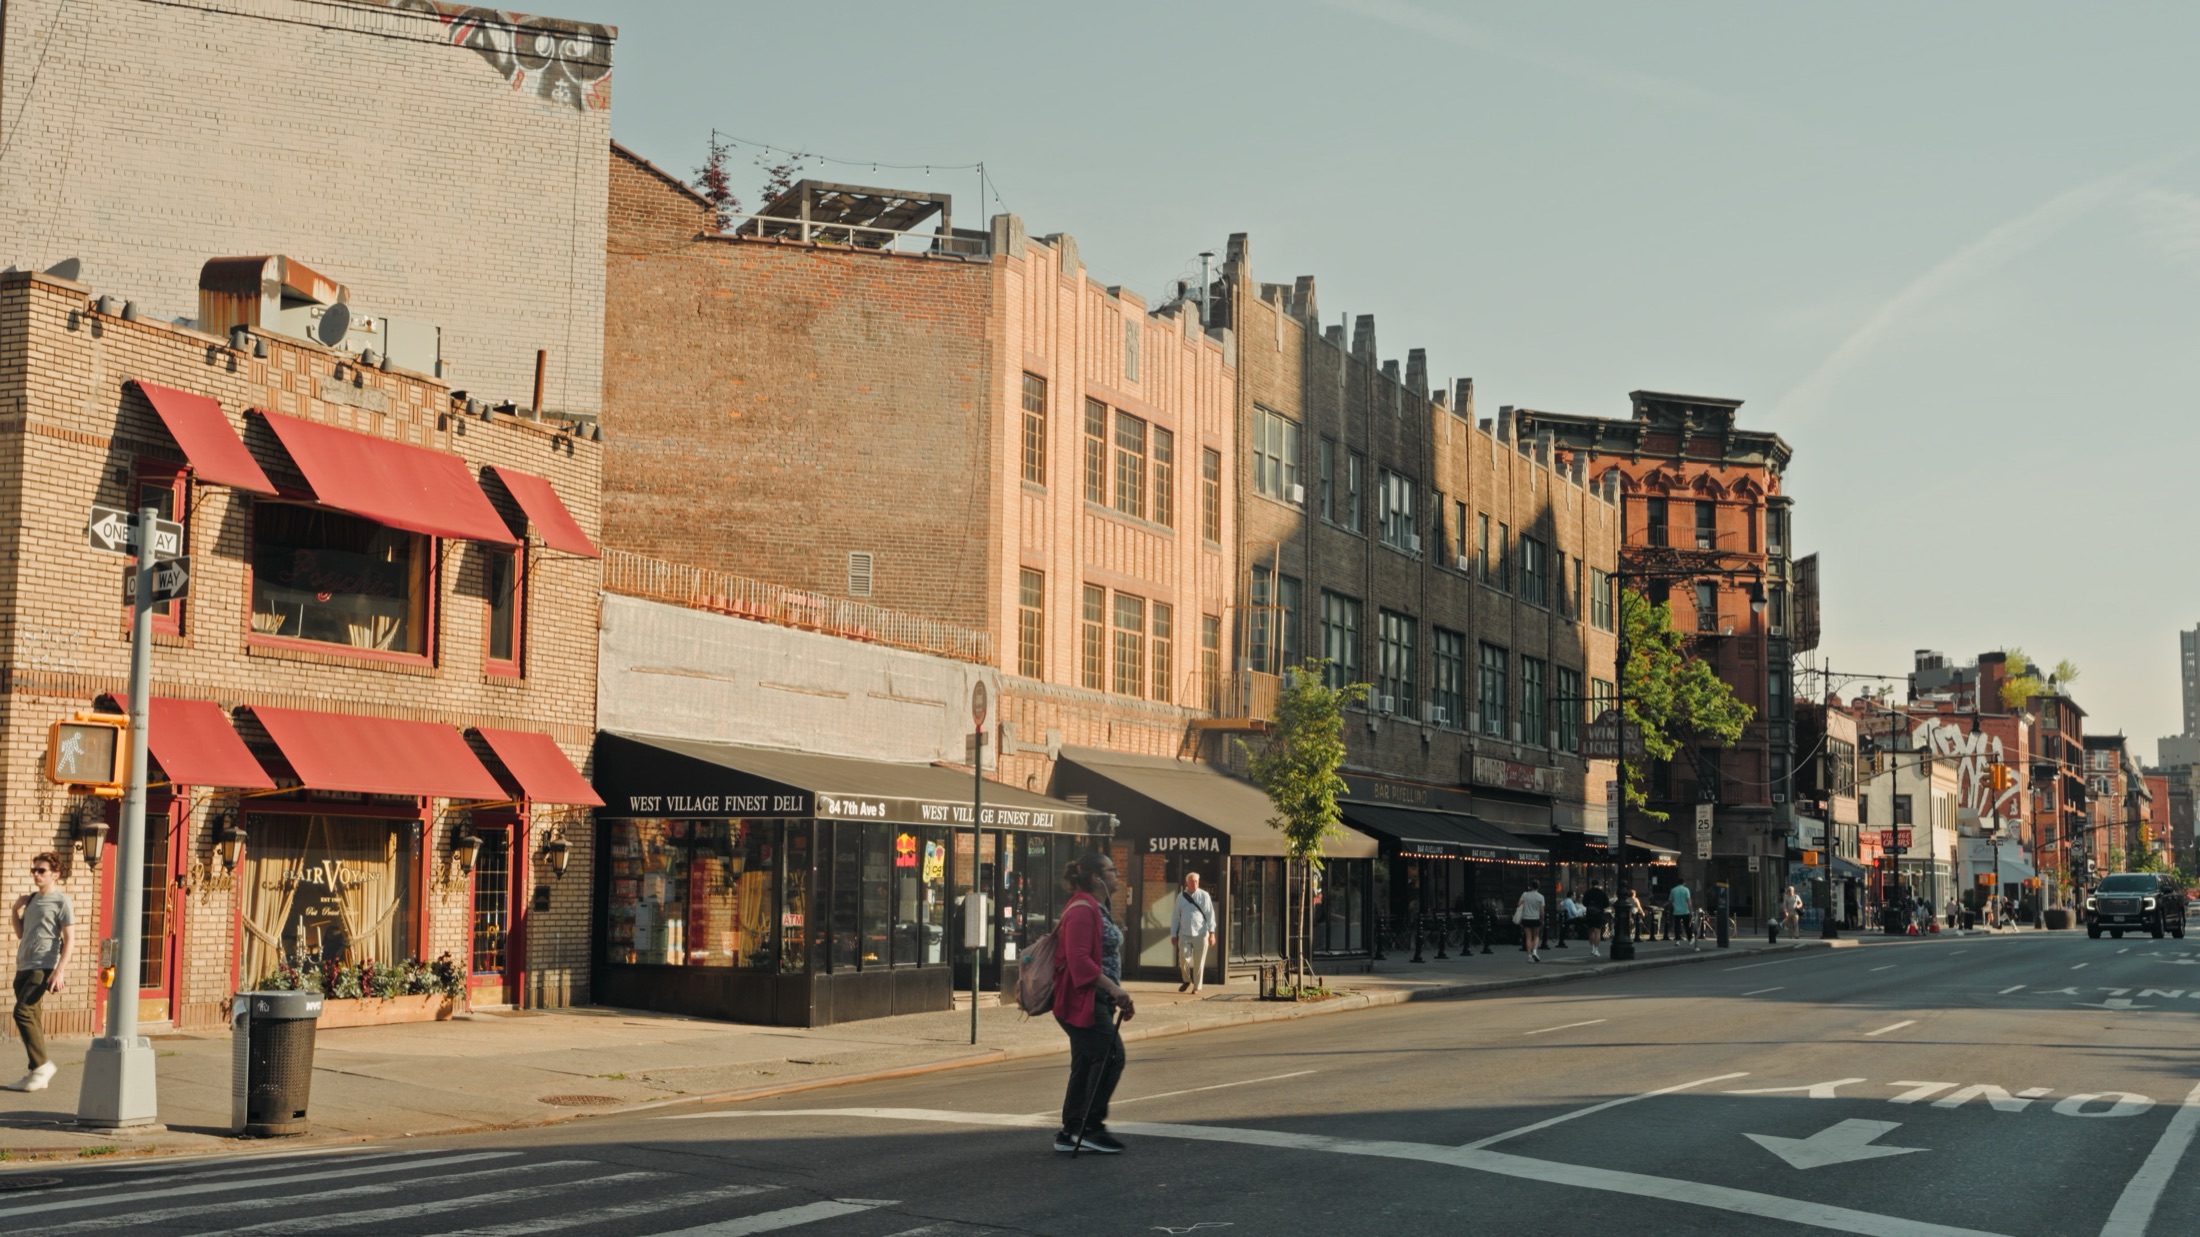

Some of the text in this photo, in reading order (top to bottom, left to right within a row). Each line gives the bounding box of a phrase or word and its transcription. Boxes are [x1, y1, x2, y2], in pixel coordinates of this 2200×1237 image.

[103, 522, 174, 550] ONE AY
[158, 570, 181, 588] WAY
[1374, 783, 1390, 799] BAR
[630, 796, 803, 811] WEST VILLAGE FINEST DELI
[842, 800, 858, 815] 7th
[860, 801, 877, 816] Ave
[878, 802, 886, 817] S
[922, 804, 1054, 827] WEST VILLGE FINEST DELI
[1698, 819, 1710, 830] 25
[1149, 837, 1220, 852] SUPREMA
[283, 860, 380, 893] CLAIRVOYANT
[784, 914, 804, 926] ATM
[1720, 1077, 2156, 1118] ONLY
